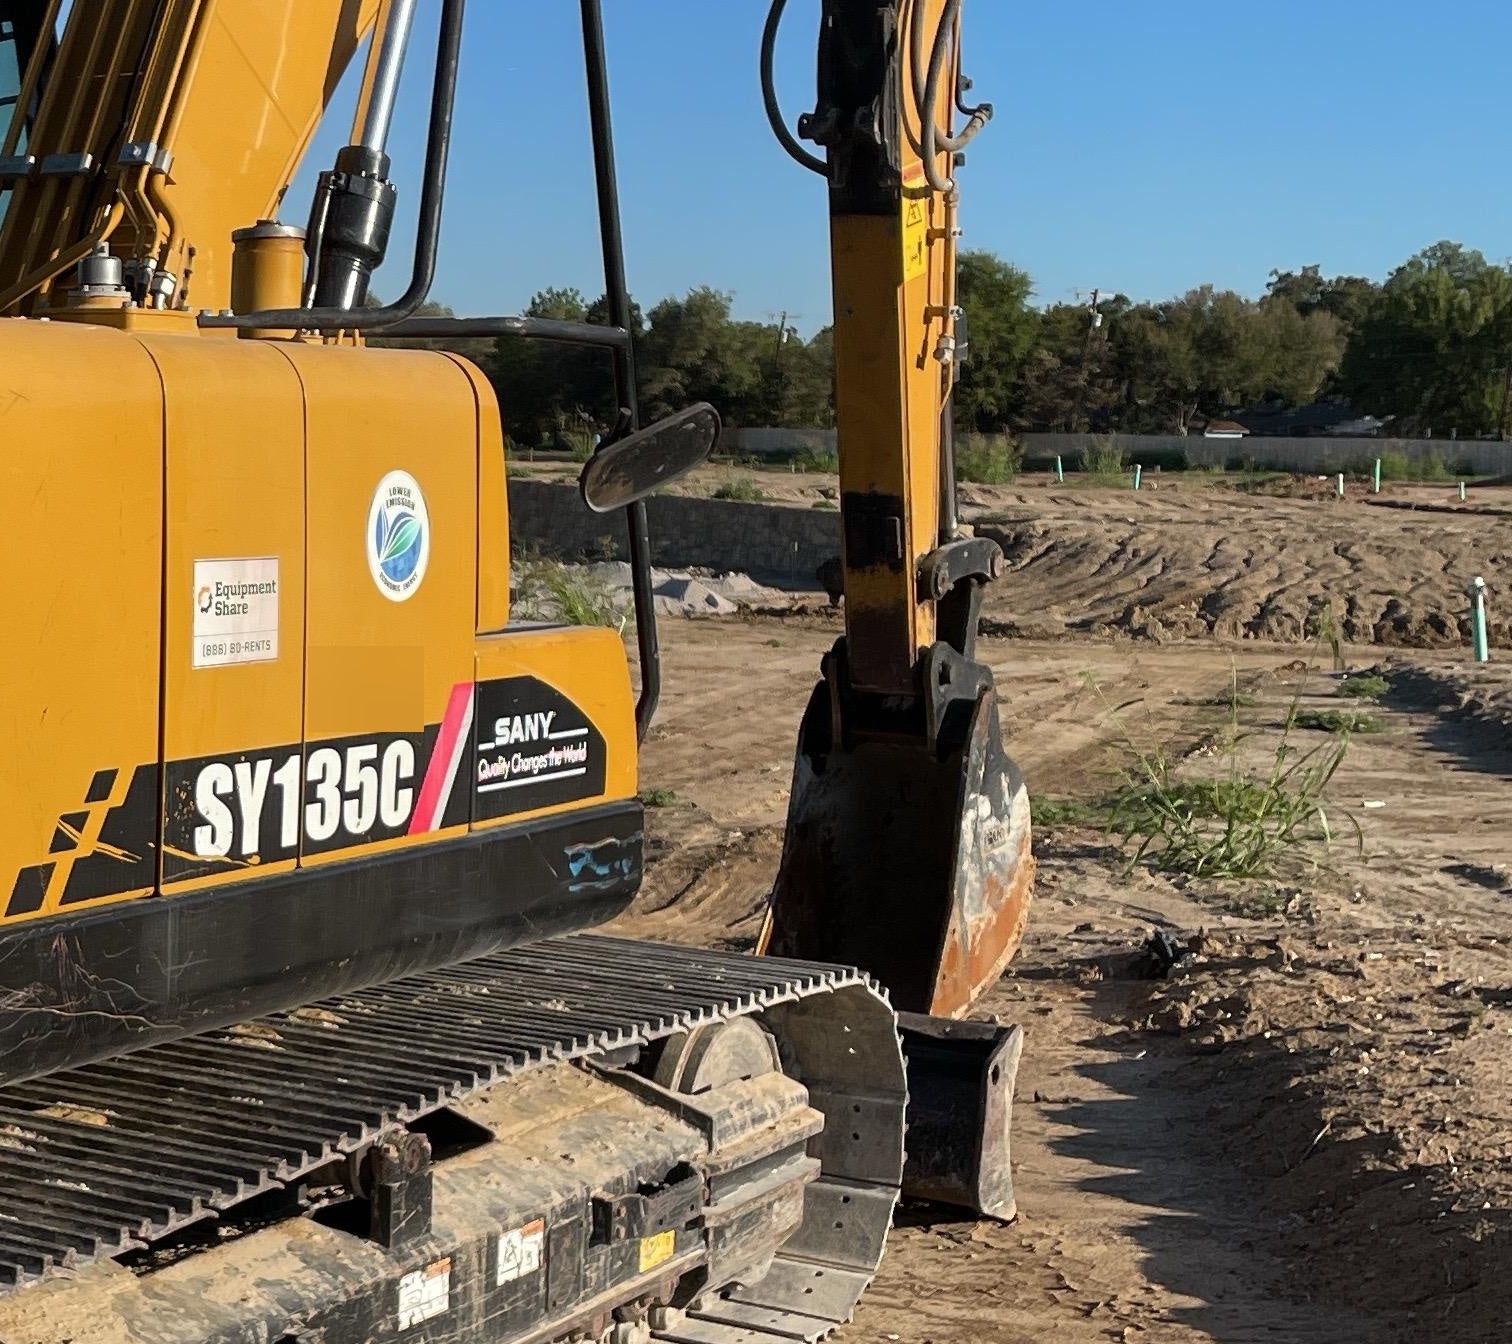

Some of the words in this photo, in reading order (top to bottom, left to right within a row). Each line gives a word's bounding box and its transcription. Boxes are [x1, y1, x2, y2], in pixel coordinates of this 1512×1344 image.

[215, 580, 276, 600] Equipment
[215, 600, 248, 616] Share
[202, 643, 227, 657] (888)
[229, 639, 271, 654] 80-RENTS
[495, 711, 553, 746] SANY
[512, 752, 548, 775] Changes
[194, 739, 415, 857] SY135C
